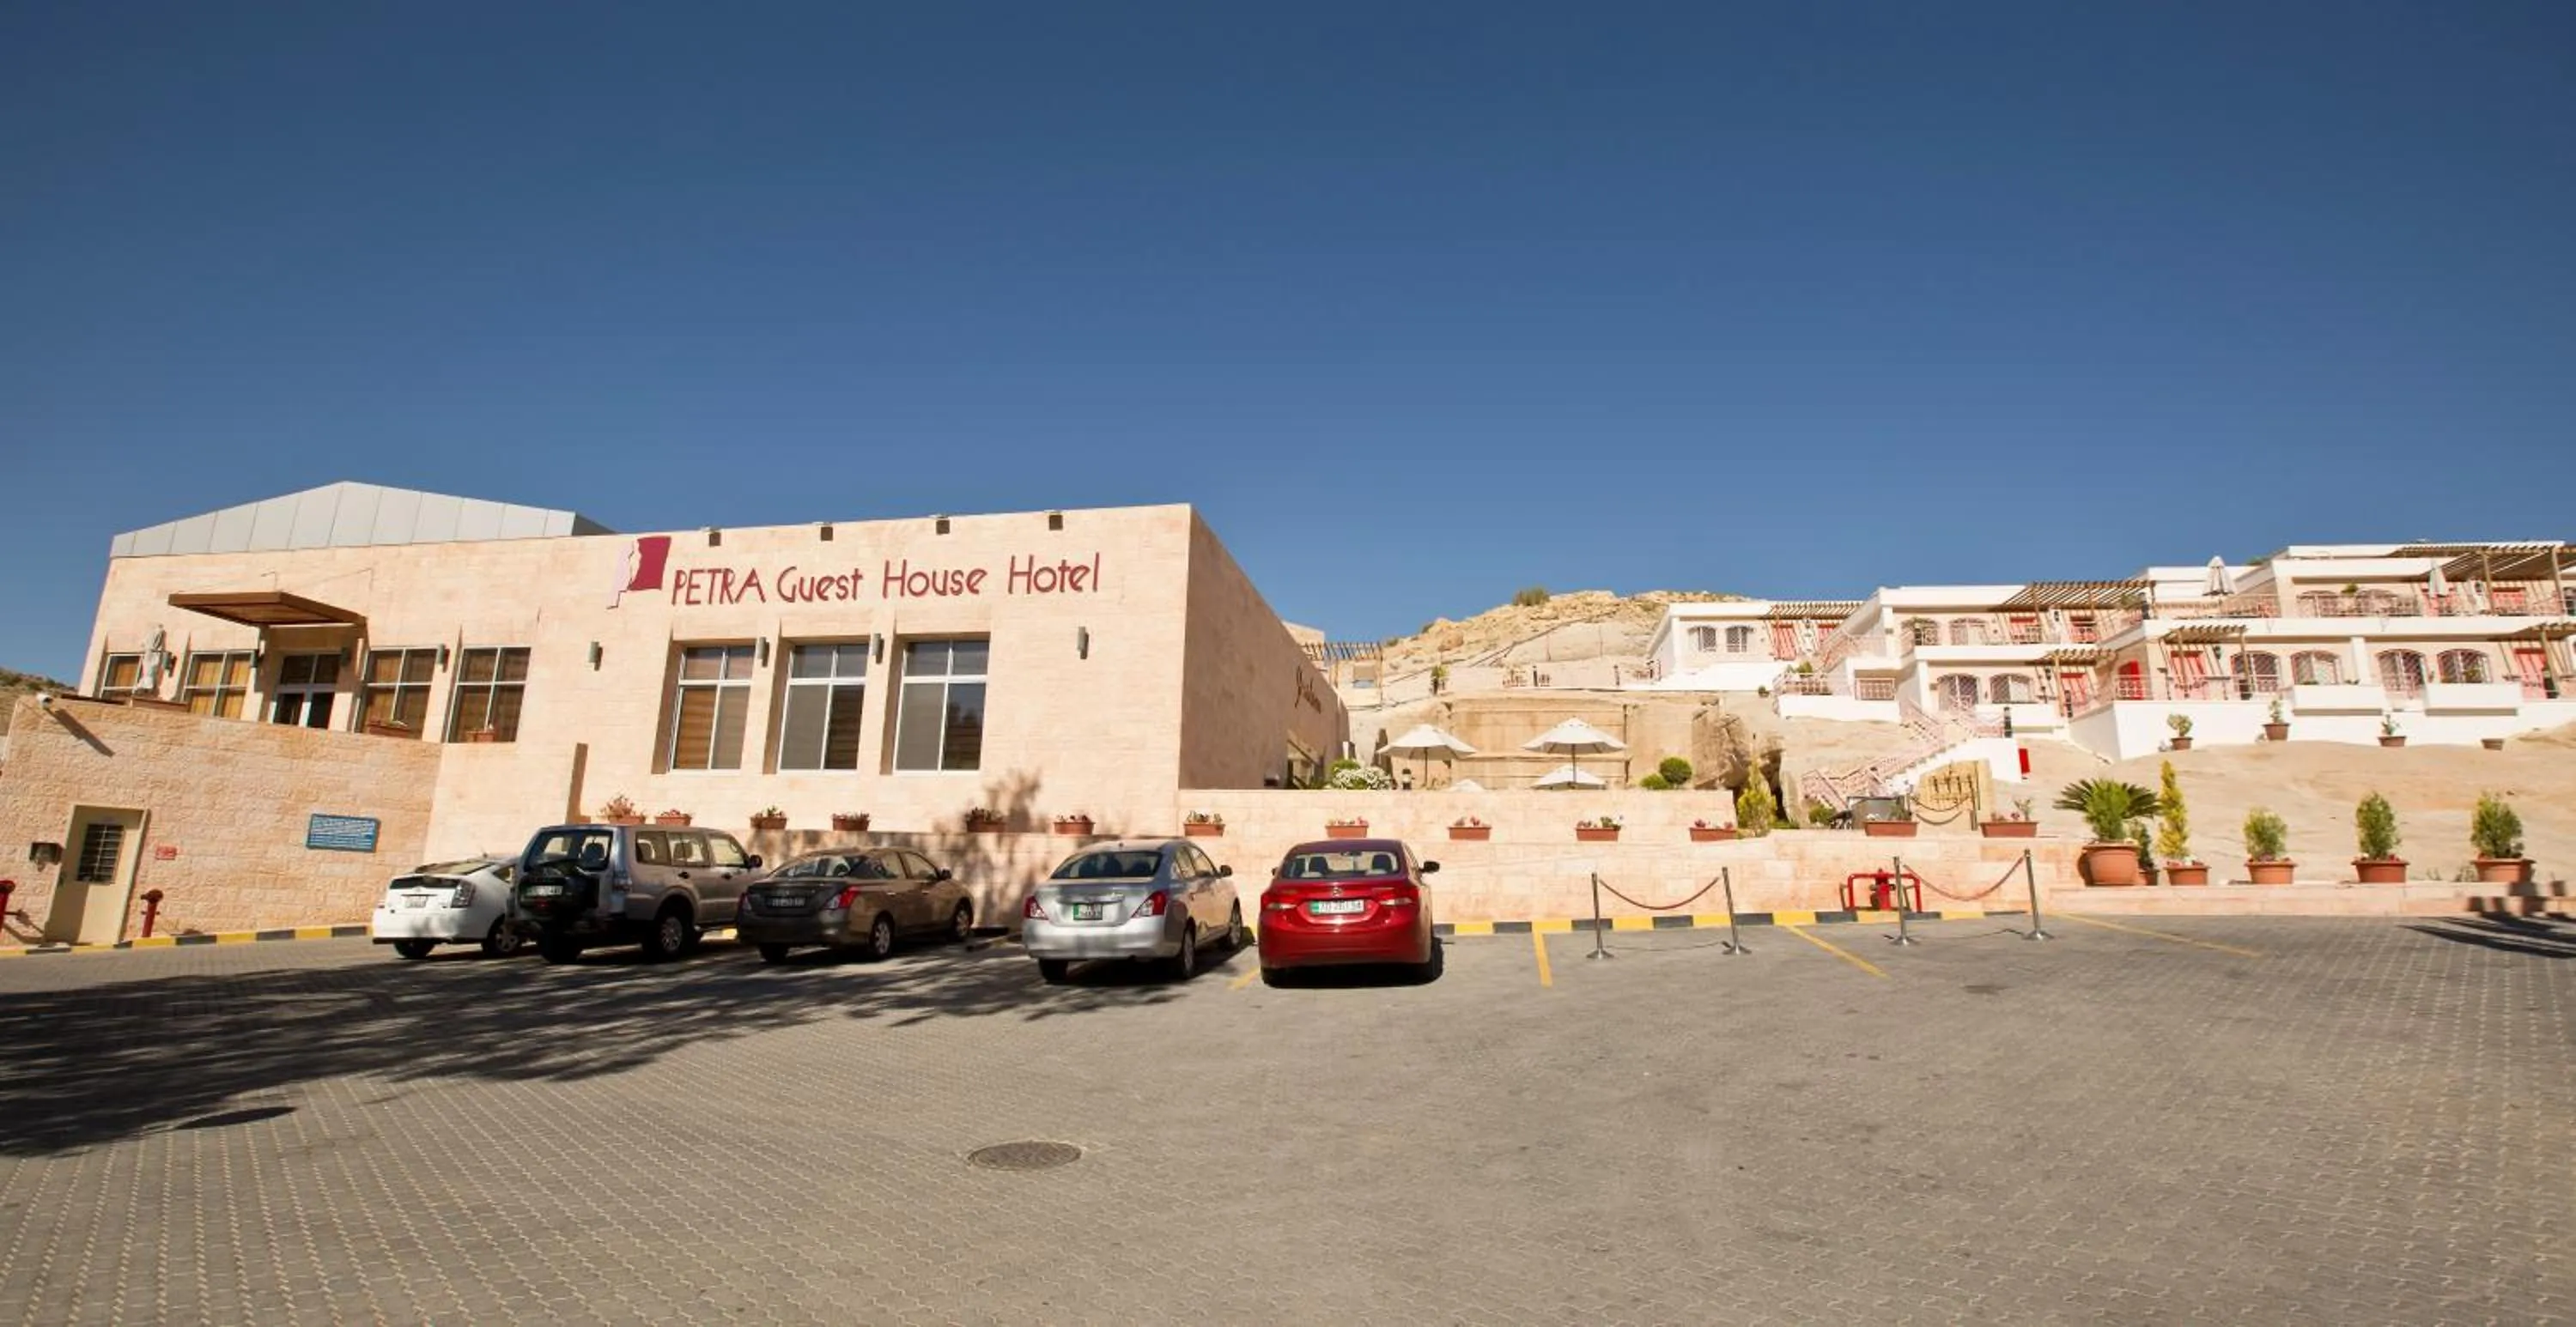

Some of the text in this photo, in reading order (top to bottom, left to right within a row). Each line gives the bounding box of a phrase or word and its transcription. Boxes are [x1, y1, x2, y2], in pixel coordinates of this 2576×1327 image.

[671, 552, 1100, 606] PETRA Guest House Hotel
